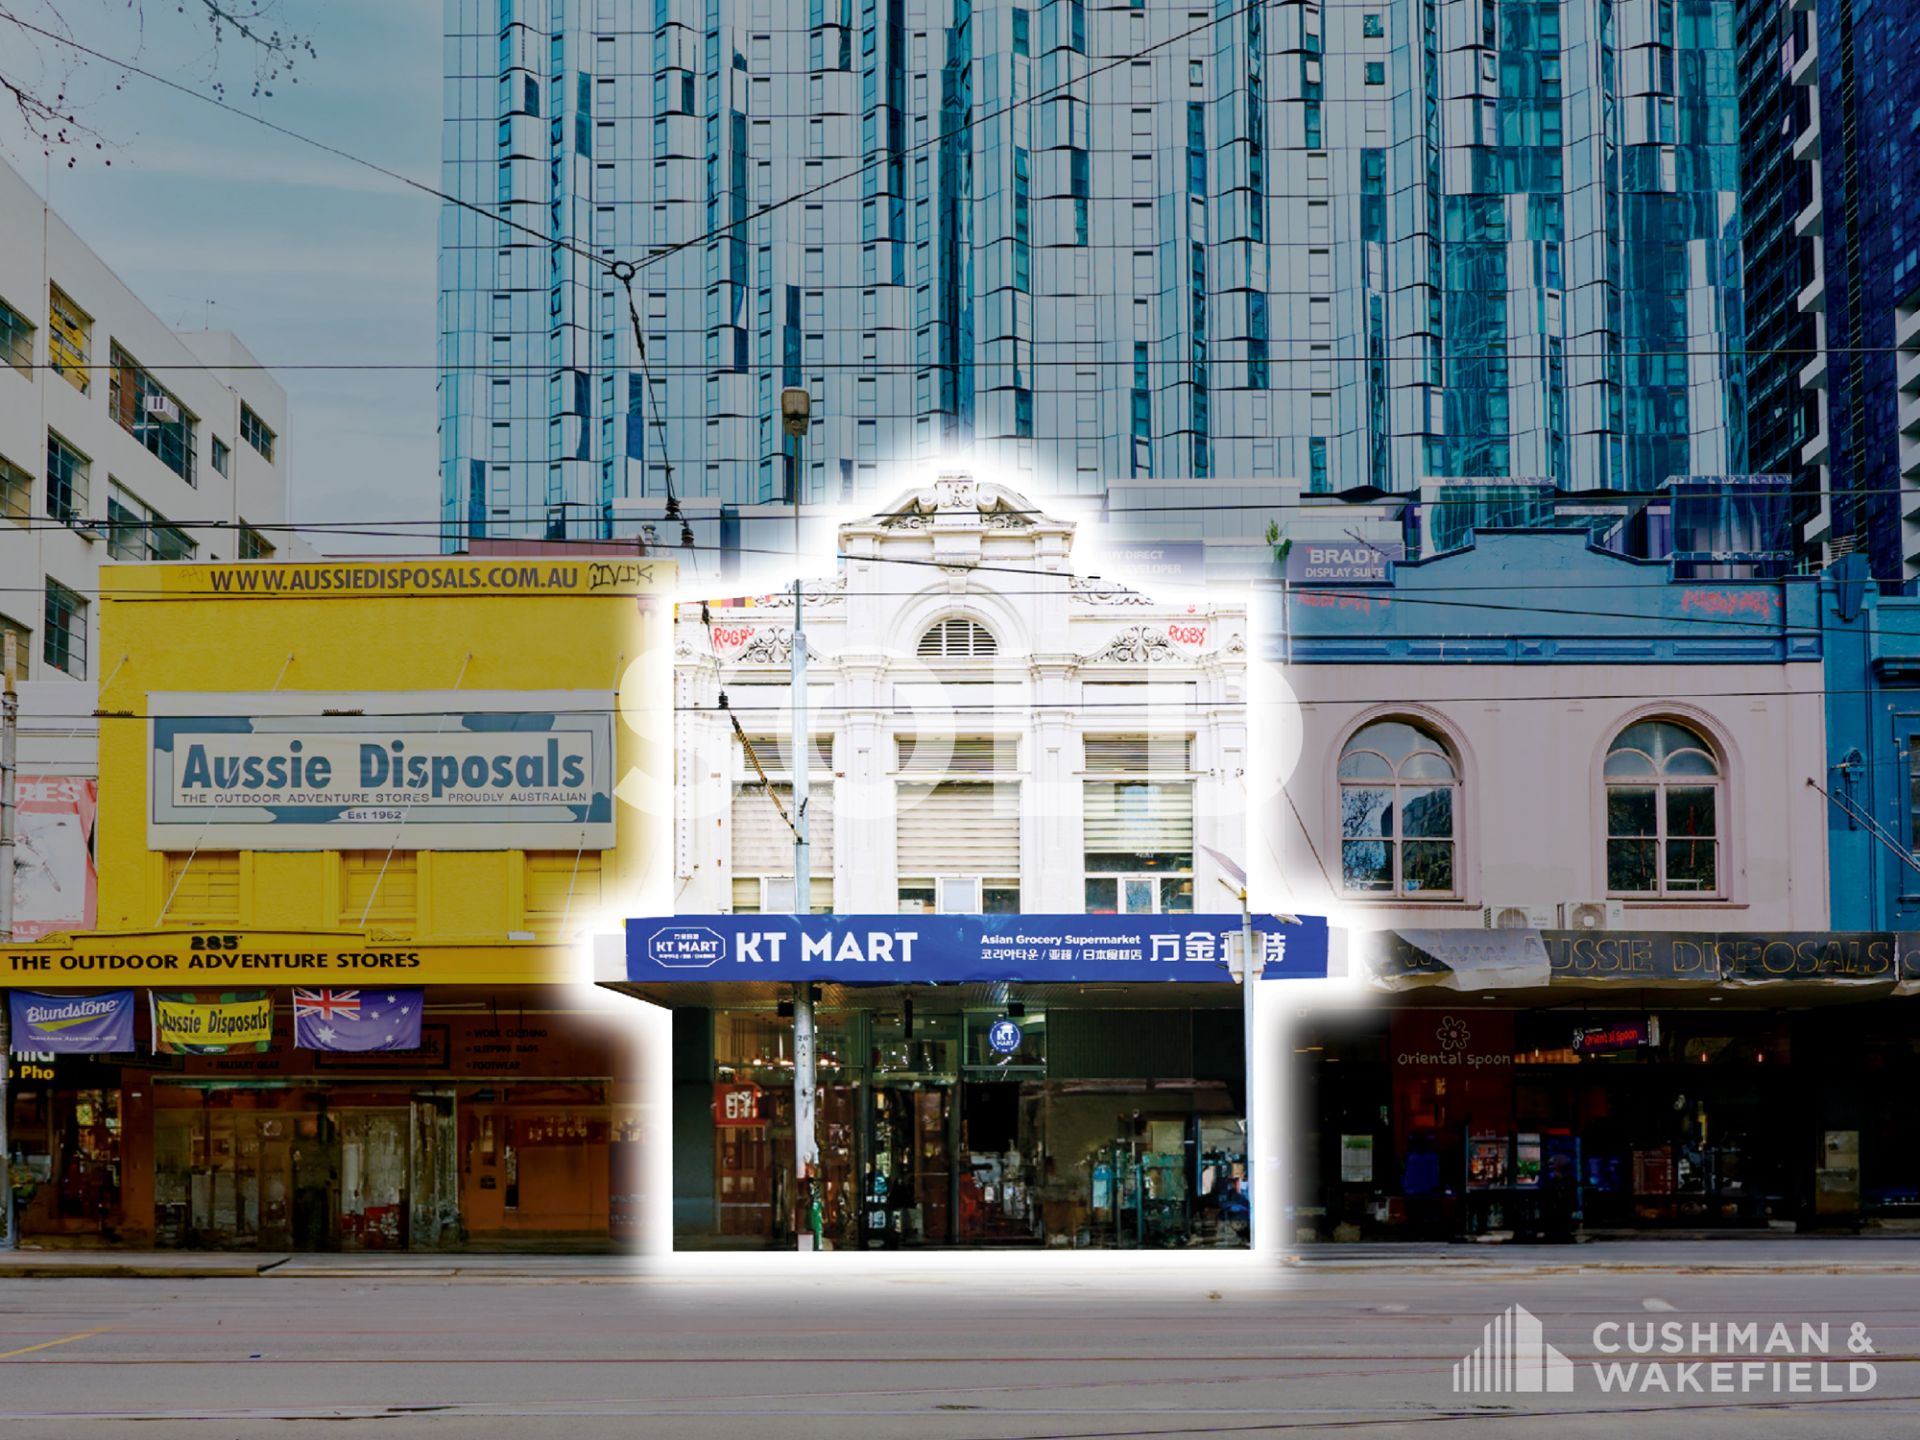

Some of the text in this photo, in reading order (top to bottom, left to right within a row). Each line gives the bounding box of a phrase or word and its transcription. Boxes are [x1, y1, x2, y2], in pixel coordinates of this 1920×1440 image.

[1127, 550, 1165, 560] DIRECT
[1309, 549, 1381, 564] BRADY
[210, 567, 578, 591] WWW.AUSSIEDISPOSALS.COM.AU
[1305, 567, 1385, 578] DISPLAY SUITE
[1168, 625, 1206, 646] RUGBY
[182, 738, 585, 798] Aussie Disposals
[182, 792, 587, 803] THE OUTDOOR ADVENTURE STORES PROUDLY AUSTRALIAN
[347, 811, 402, 820] Est 1962
[190, 936, 239, 950] 285
[656, 941, 719, 952] KT MART
[736, 931, 918, 962] KT MART
[981, 935, 1141, 946] Asian Grocery Supermarket
[9, 953, 420, 970] THE OUTDOOR ADVENTURE STORES
[981, 949, 1039, 960] 코리아타운
[1672, 940, 1889, 974] DISPOSALS
[26, 1000, 119, 1023] Blundstone
[161, 1005, 269, 1037] Aussie Disposals
[996, 1029, 1014, 1040] KT
[472, 1061, 521, 1070] FOOTWEAR
[1466, 1054, 1511, 1069] spoon
[20, 1065, 55, 1080] Pho
